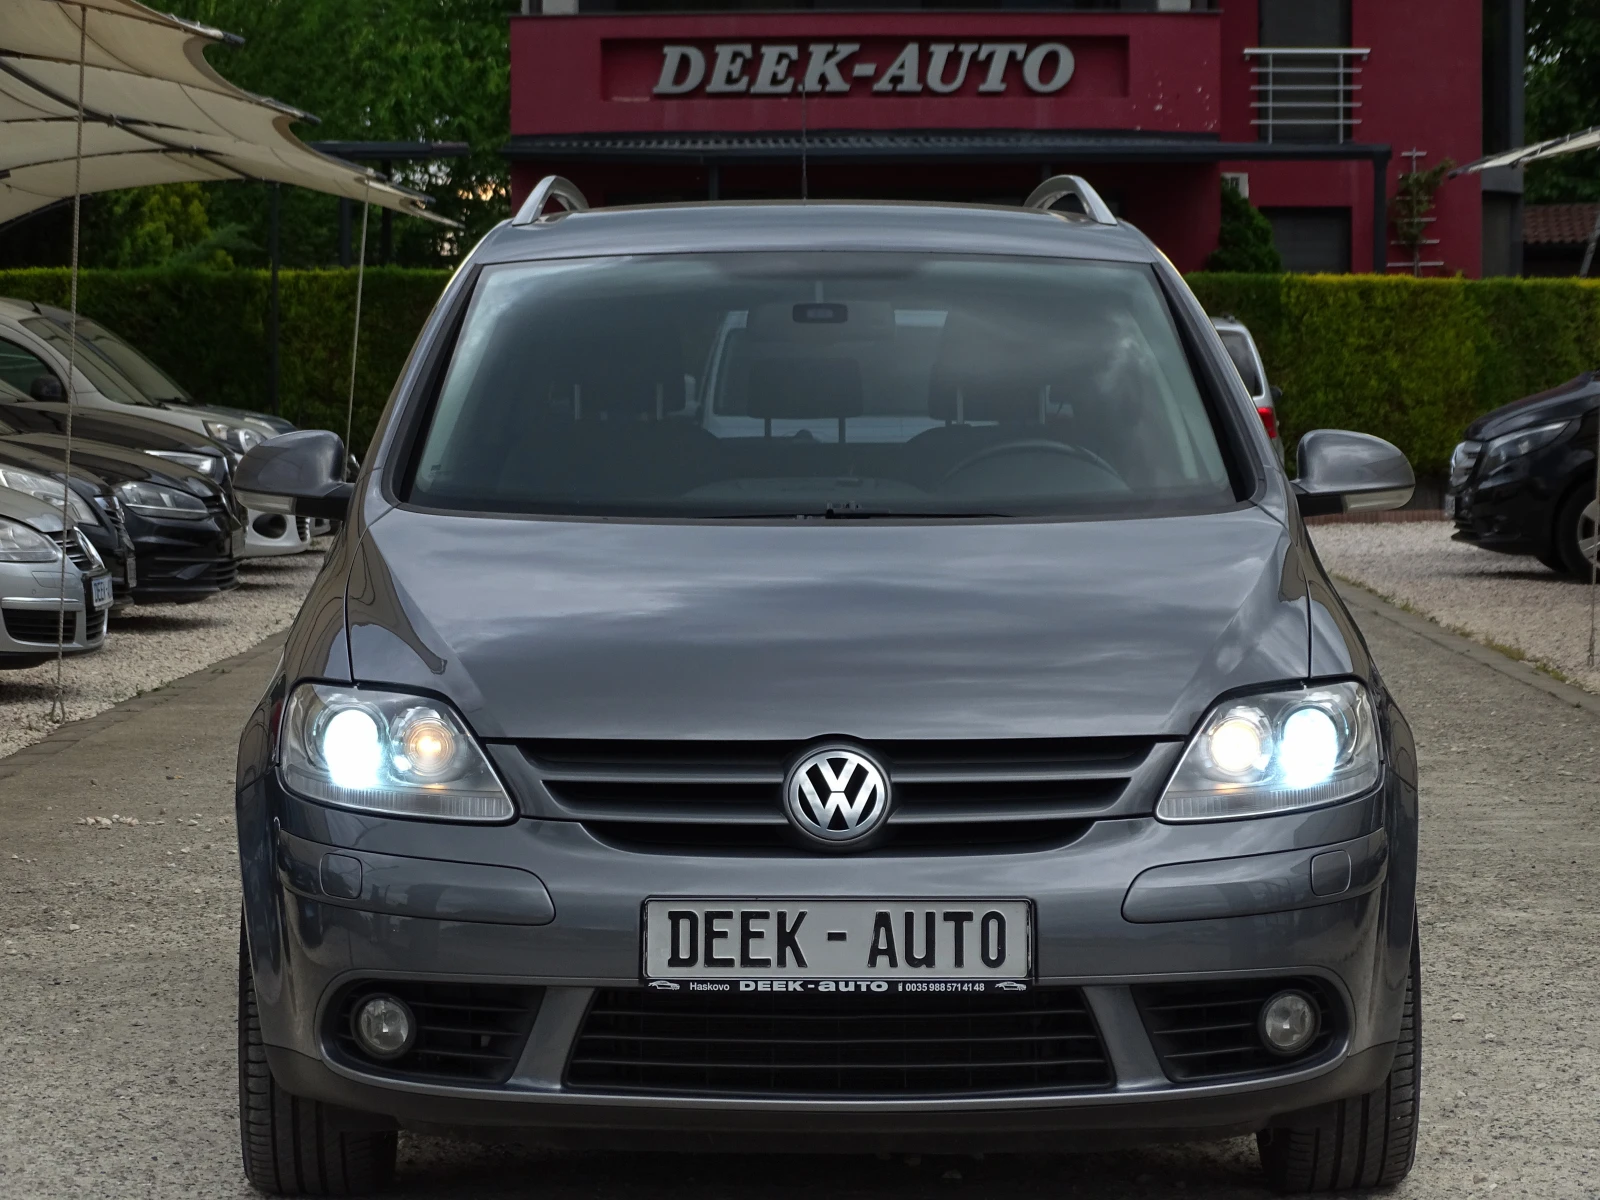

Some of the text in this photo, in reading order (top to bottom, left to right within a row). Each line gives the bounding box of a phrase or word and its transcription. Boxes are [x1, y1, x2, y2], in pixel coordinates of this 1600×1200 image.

[652, 42, 1076, 95] DEEK-AUTO
[667, 910, 808, 968] DEEK
[867, 910, 1007, 968] AUTO
[689, 982, 730, 991] Haskovo
[905, 983, 928, 992] 0035
